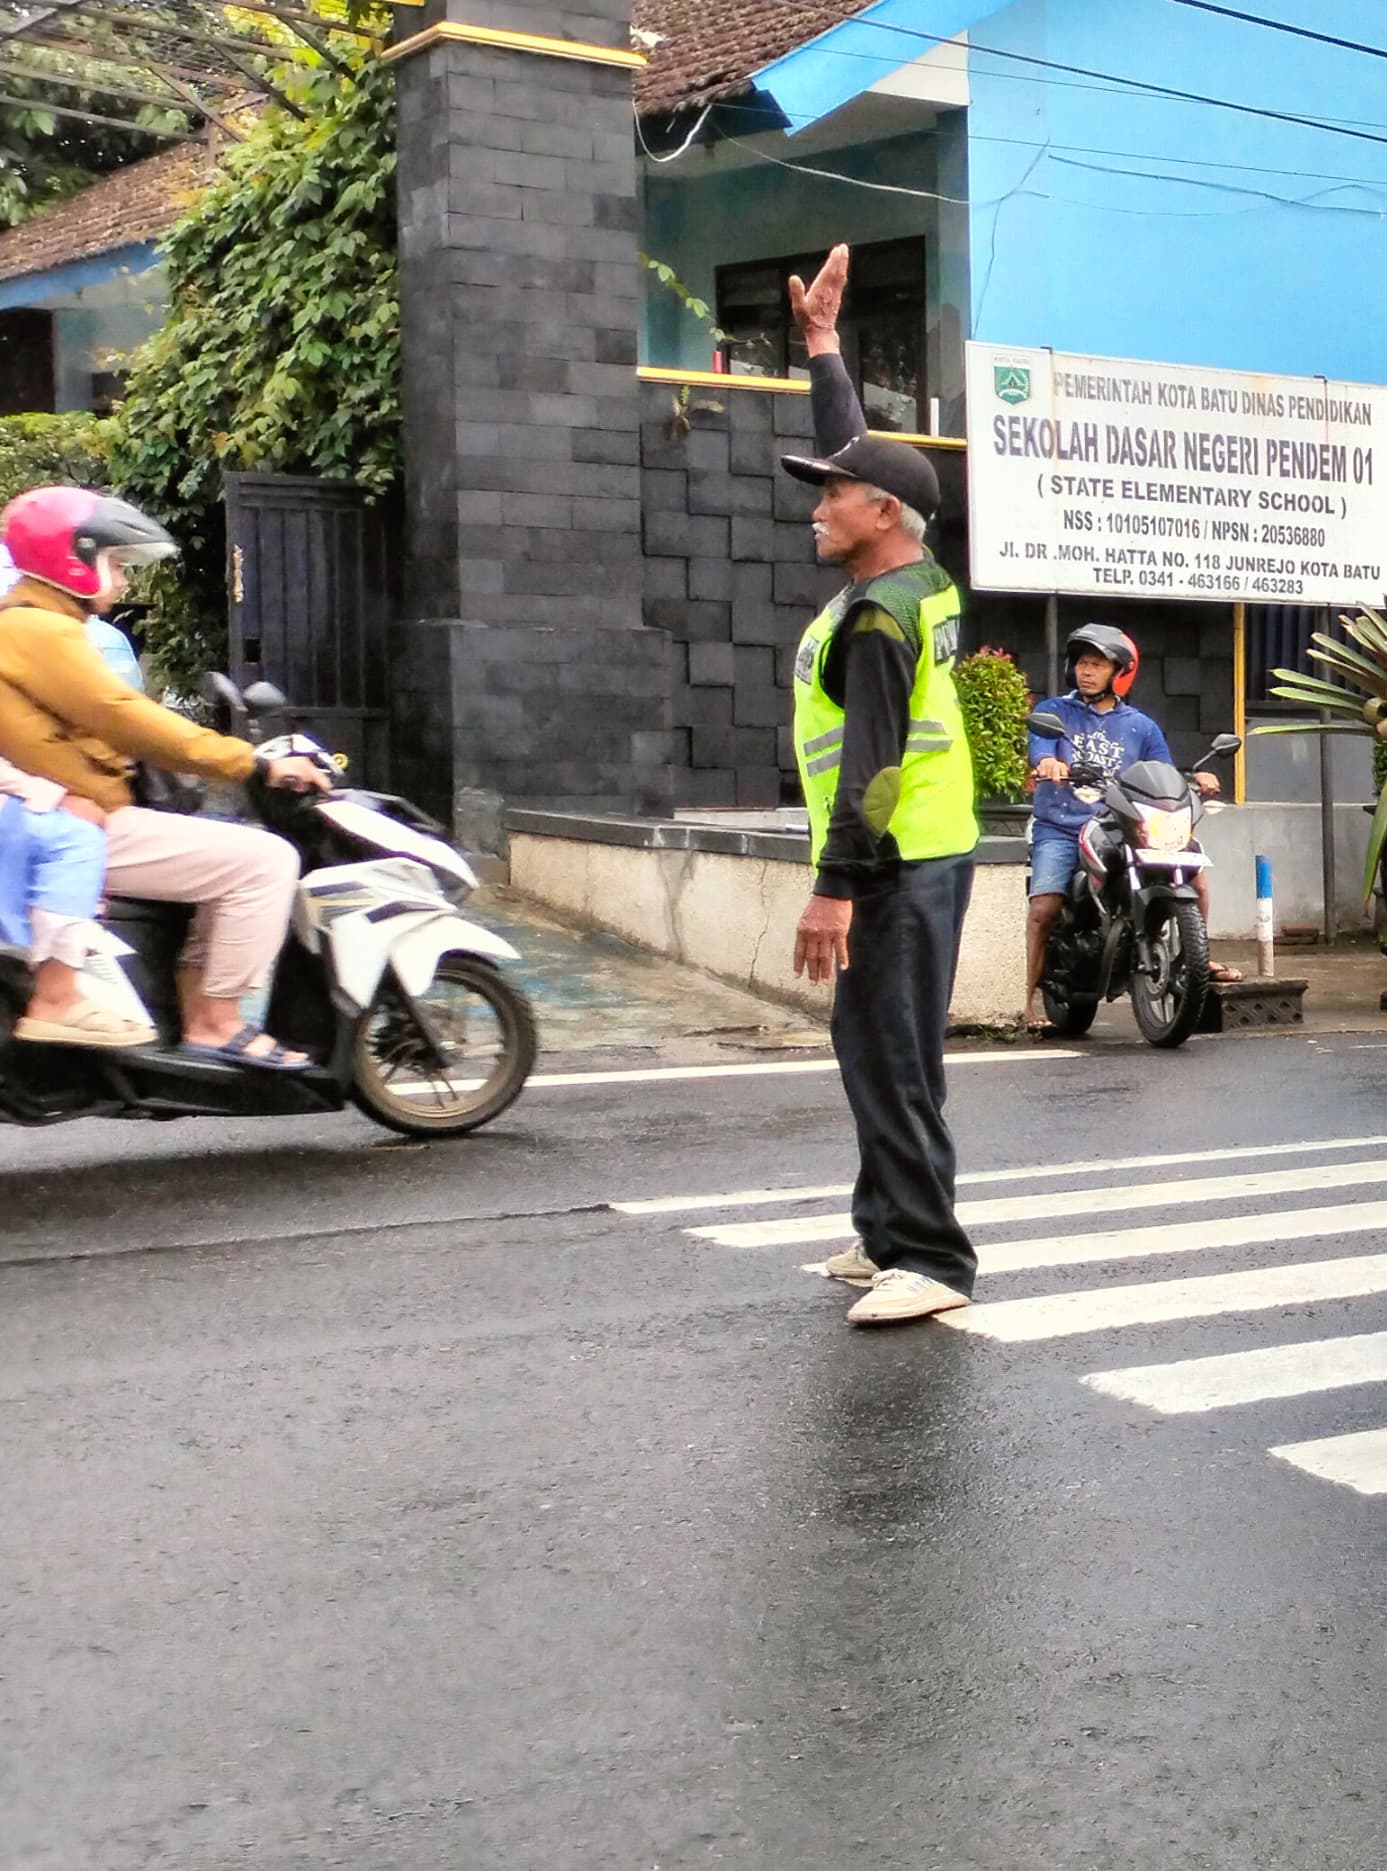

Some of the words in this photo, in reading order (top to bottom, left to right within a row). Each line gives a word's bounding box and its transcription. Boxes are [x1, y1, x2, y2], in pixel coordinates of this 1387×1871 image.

[1053, 371, 1152, 405] PEMERINTAH
[1158, 382, 1197, 409] KOTA
[1201, 387, 1238, 414] BATU
[1242, 392, 1284, 418] DINAS
[1289, 395, 1371, 426] PENDIDIKAN
[994, 414, 1098, 463] SEKOLAH
[1106, 424, 1178, 469] DASAR
[1184, 431, 1259, 476] NEGERI
[1266, 438, 1347, 483] PENDEM
[1353, 447, 1372, 485] 01
[1050, 475, 1114, 498] STATE
[1121, 480, 1252, 509] ELEMENTARY
[1258, 490, 1335, 514] SCHOOL
[1064, 510, 1093, 531] NSS
[1106, 512, 1200, 539] 10105107016
[1212, 520, 1249, 542] NPSN
[1261, 524, 1325, 547] 20536880
[1025, 542, 1047, 559] DR
[1105, 548, 1158, 566] HATTA
[1162, 551, 1189, 569] NO.
[1195, 553, 1221, 570] 118
[1226, 555, 1295, 574] JUNREJO
[1300, 561, 1339, 578] KOTA
[1343, 564, 1380, 580] BATU
[1093, 567, 1133, 585] TELP.
[1138, 570, 1174, 587] 0341
[1187, 573, 1240, 591] 463166
[1252, 577, 1304, 594] 463283
[1074, 733, 1125, 758] EAST
